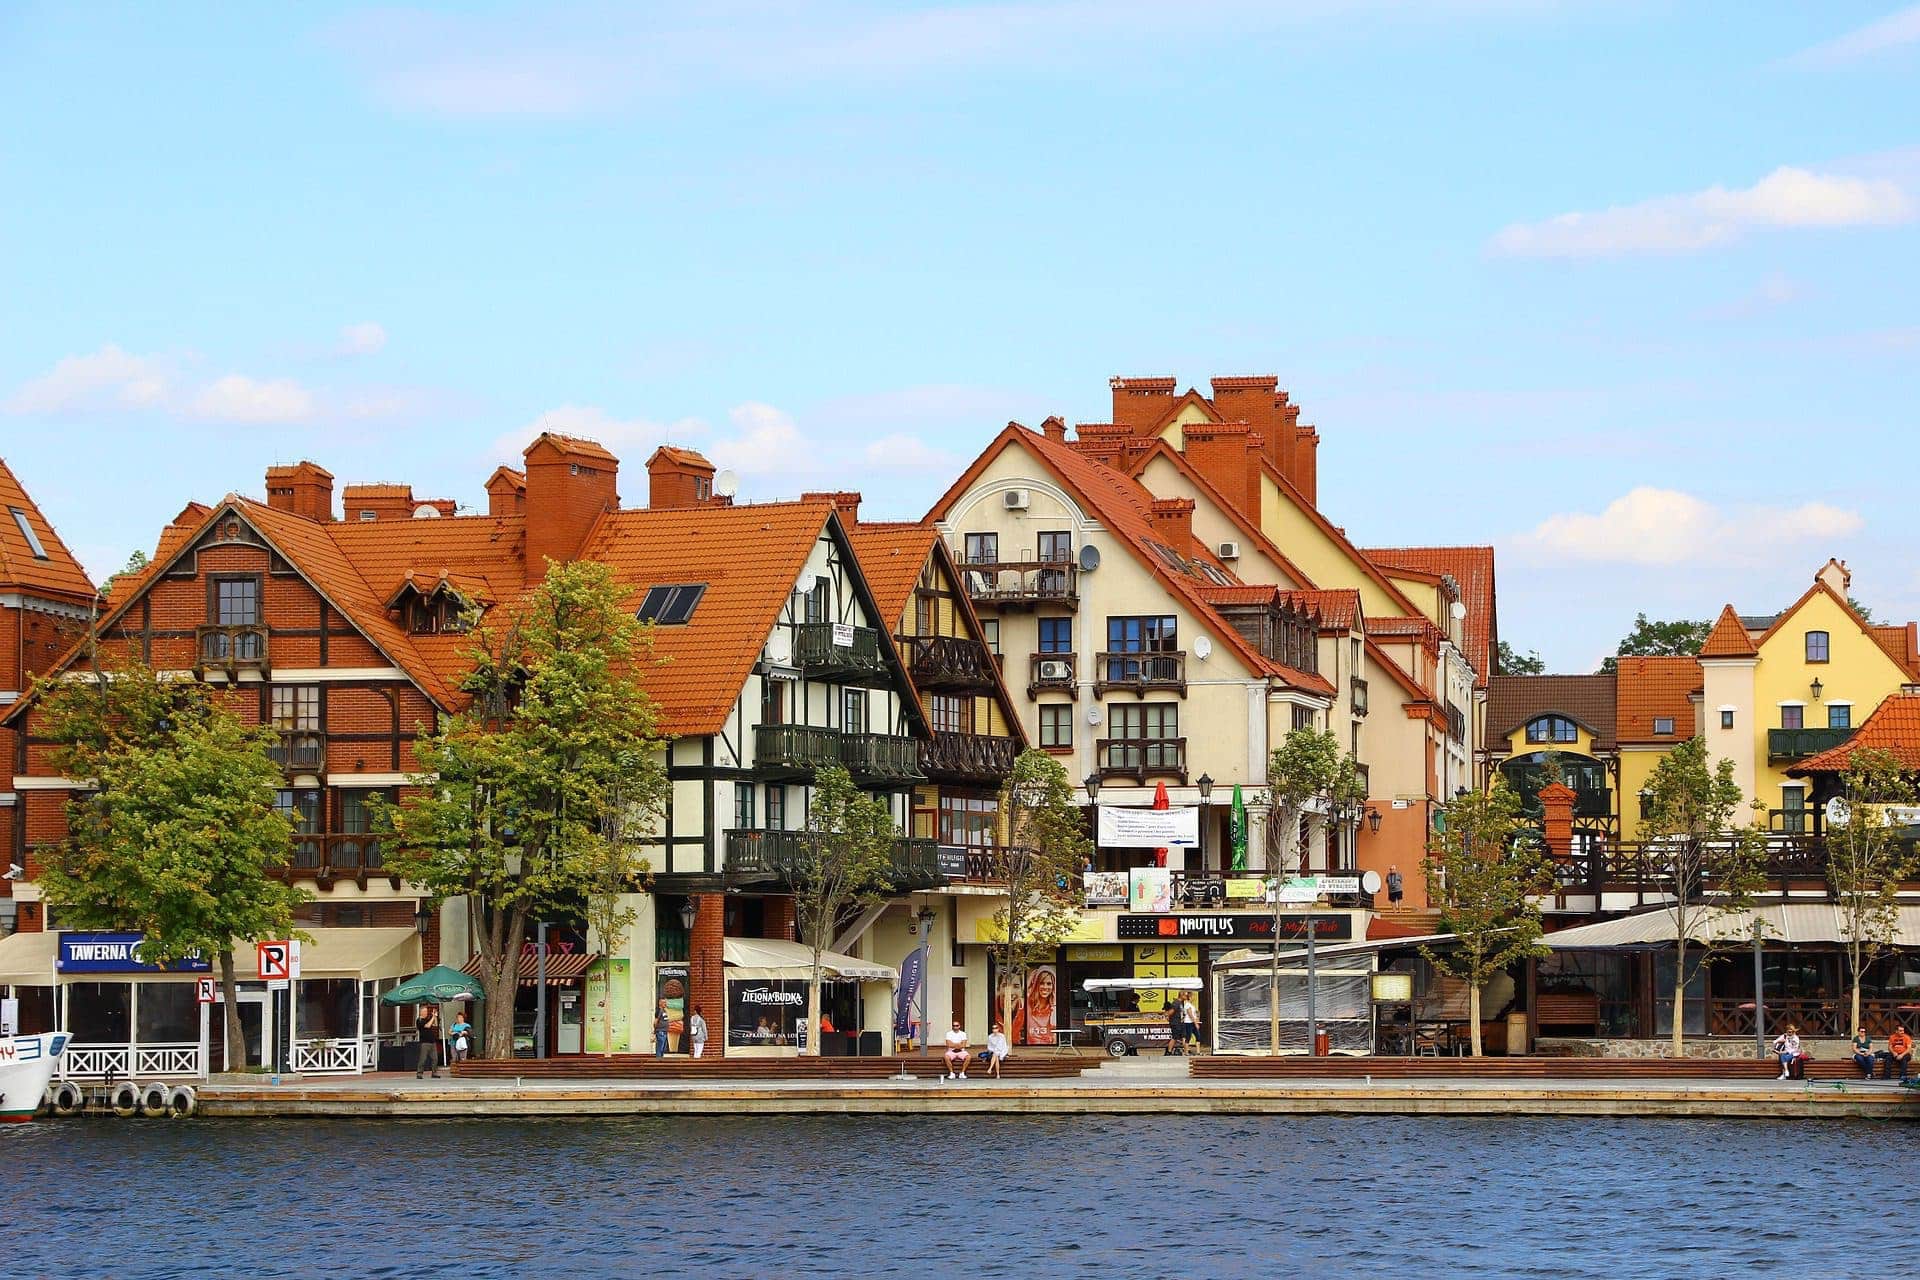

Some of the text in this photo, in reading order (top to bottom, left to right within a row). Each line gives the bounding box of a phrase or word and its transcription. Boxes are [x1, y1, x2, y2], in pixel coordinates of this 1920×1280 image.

[1180, 917, 1234, 935] NAUTILUS
[1249, 921, 1269, 933] Pub
[1316, 920, 1339, 932] Club
[69, 944, 127, 961] TAWERNA
[741, 991, 803, 1006] ZIELONA BUDKA
